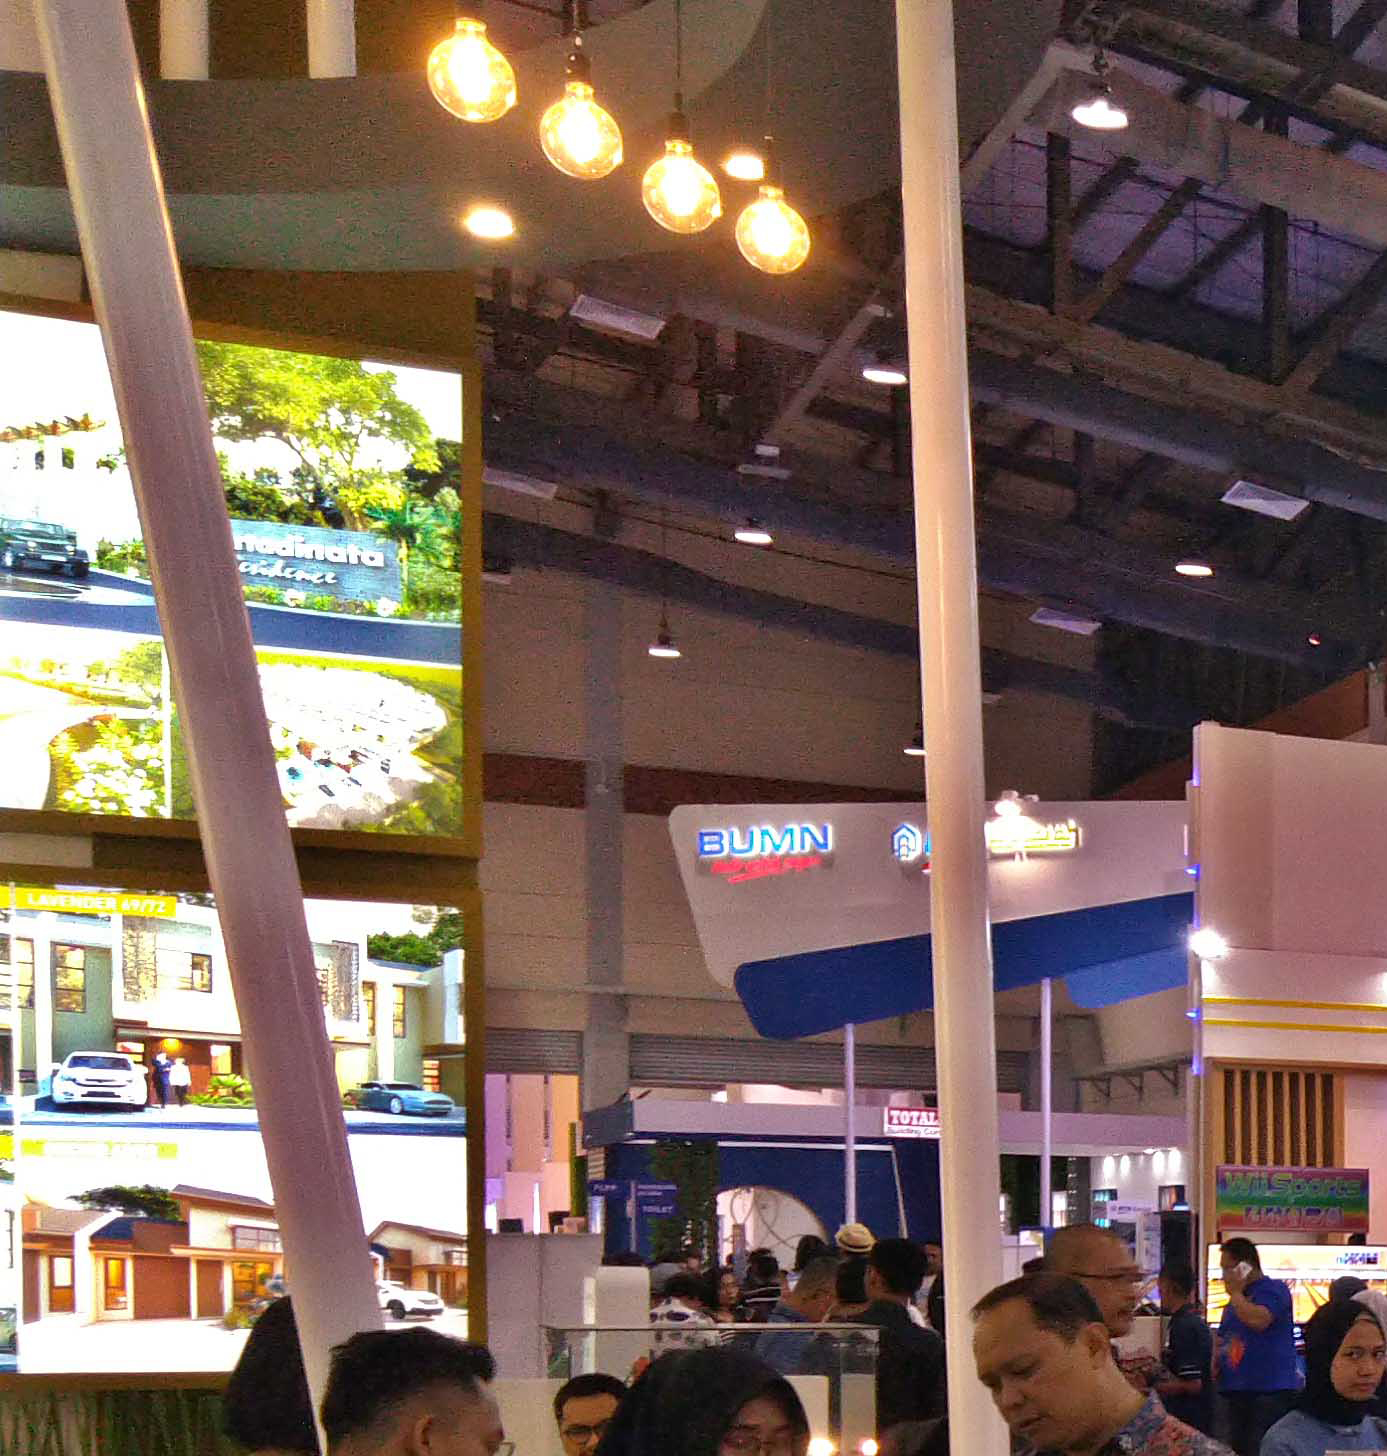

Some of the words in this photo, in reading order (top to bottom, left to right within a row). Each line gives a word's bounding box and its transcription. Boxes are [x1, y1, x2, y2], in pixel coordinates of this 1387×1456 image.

[233, 534, 385, 567] nadinata
[237, 559, 337, 584] esidence
[698, 823, 832, 857] BUMN
[28, 893, 116, 911] LAVENDER
[889, 1109, 938, 1126] TOTAL
[1267, 1171, 1361, 1206] Sports
